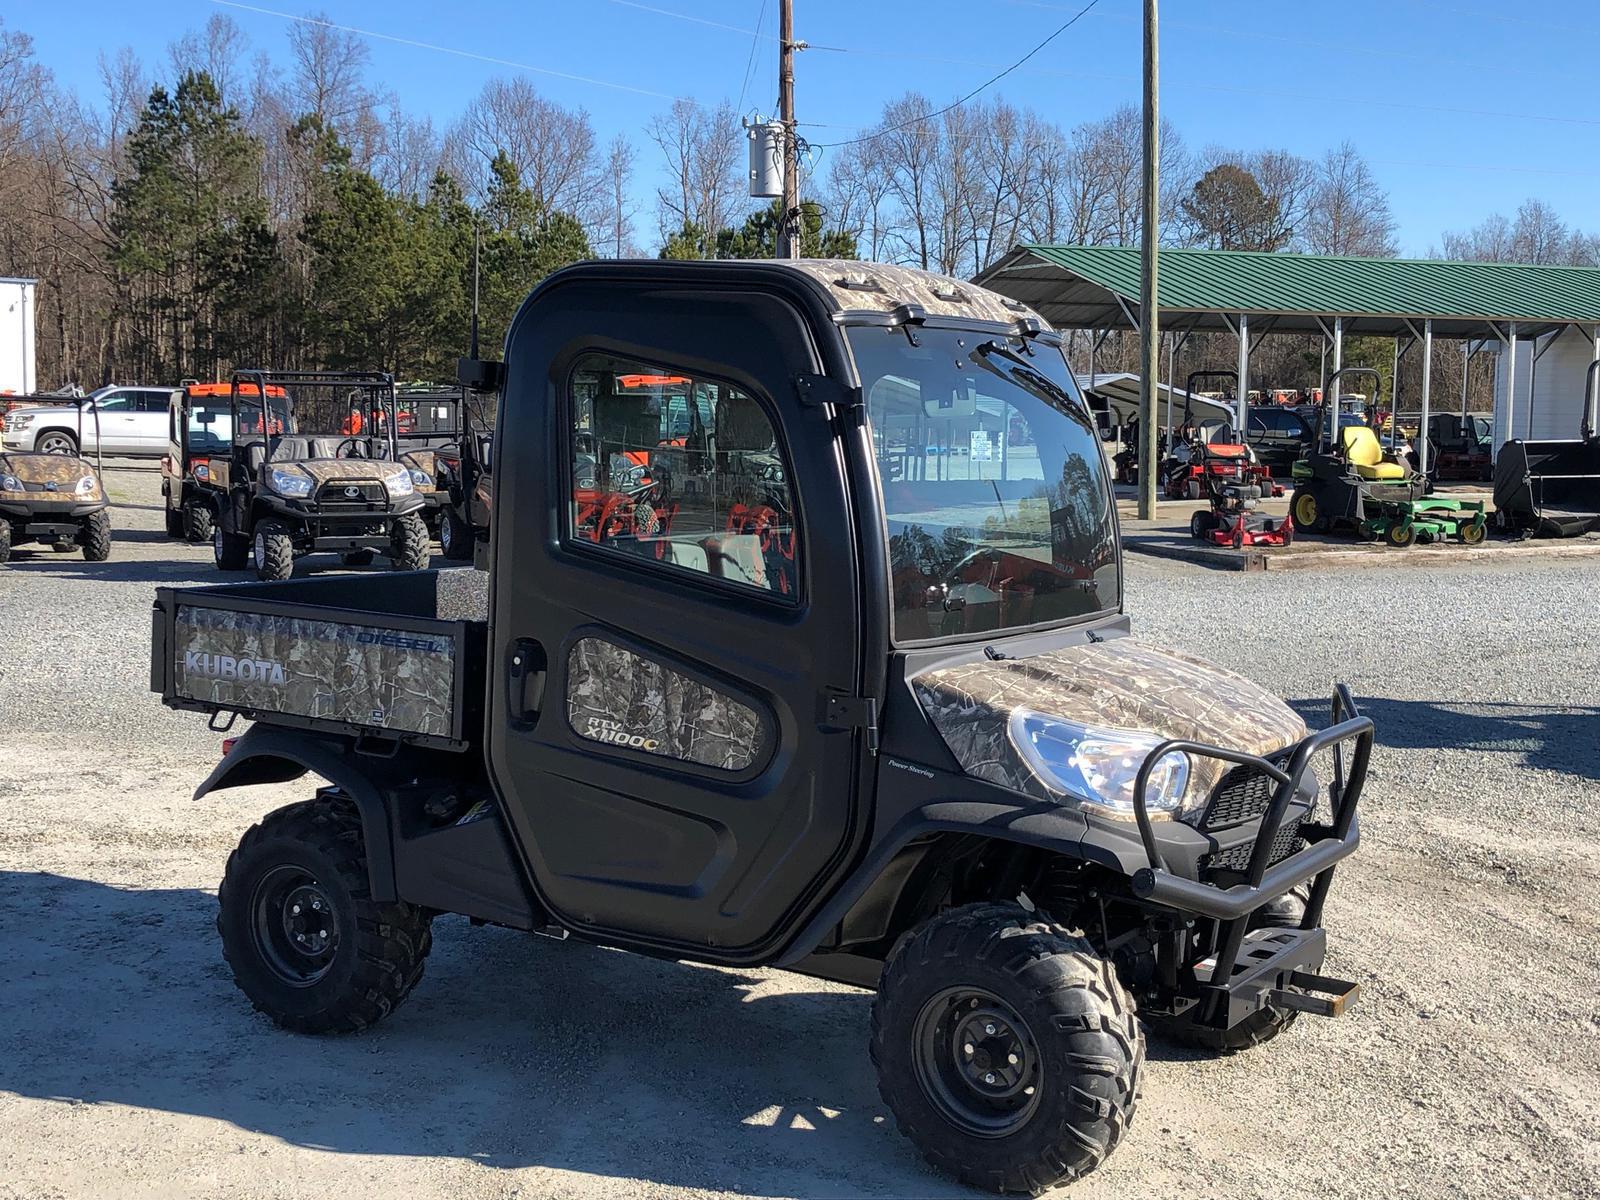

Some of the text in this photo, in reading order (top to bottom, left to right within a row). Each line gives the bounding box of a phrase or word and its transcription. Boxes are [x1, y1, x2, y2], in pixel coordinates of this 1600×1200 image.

[185, 651, 286, 686] KUBOTA
[587, 717, 622, 731] RTV
[888, 759, 935, 779] Power Steering
